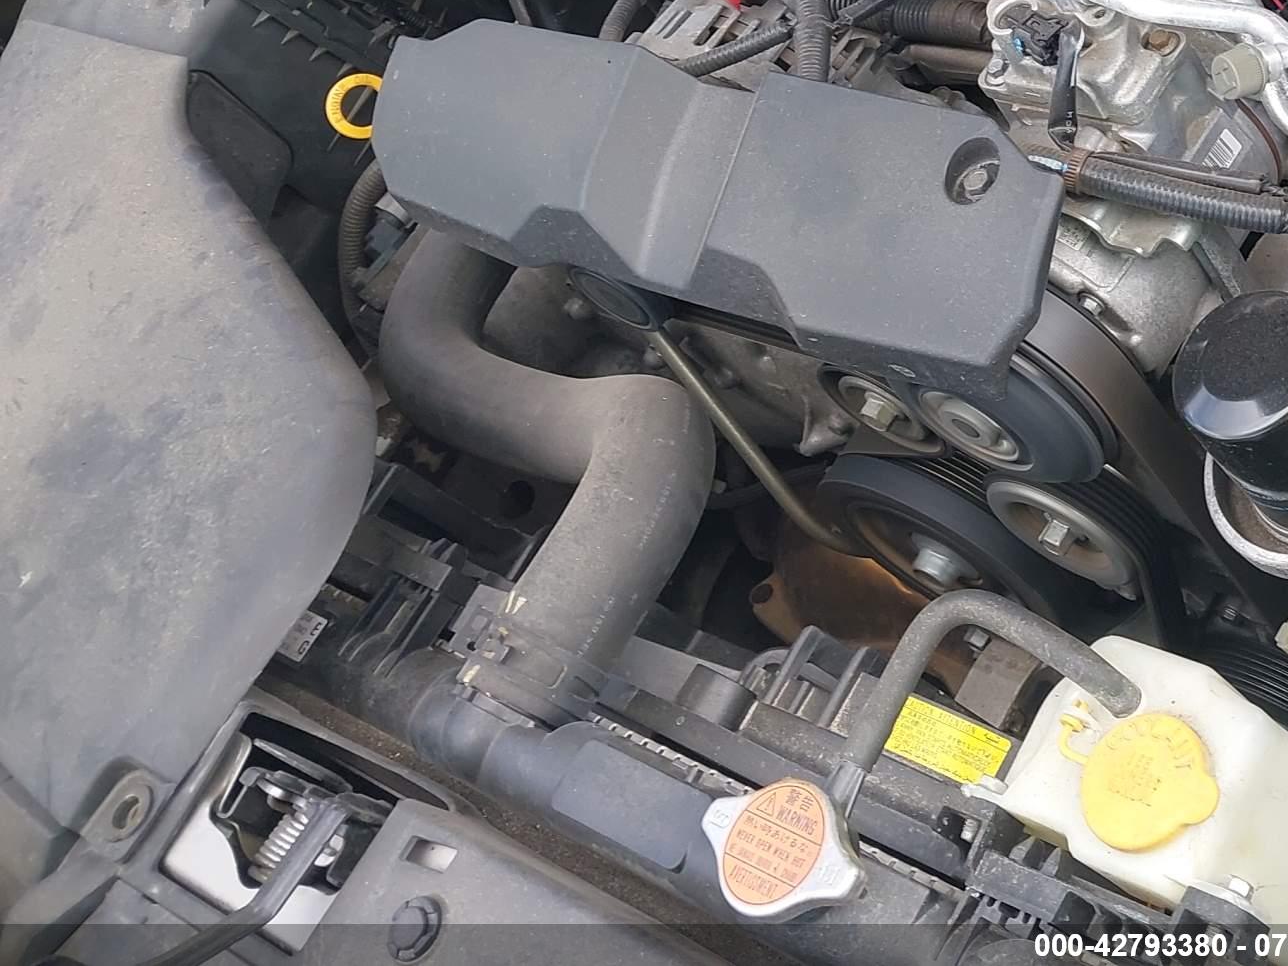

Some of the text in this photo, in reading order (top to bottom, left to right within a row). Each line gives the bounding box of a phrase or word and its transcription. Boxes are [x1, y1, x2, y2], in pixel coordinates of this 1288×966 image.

[774, 803, 819, 837] WARNING
[735, 827, 756, 845] NEVER
[754, 837, 772, 853] OPEN
[771, 845, 791, 862] WHEN
